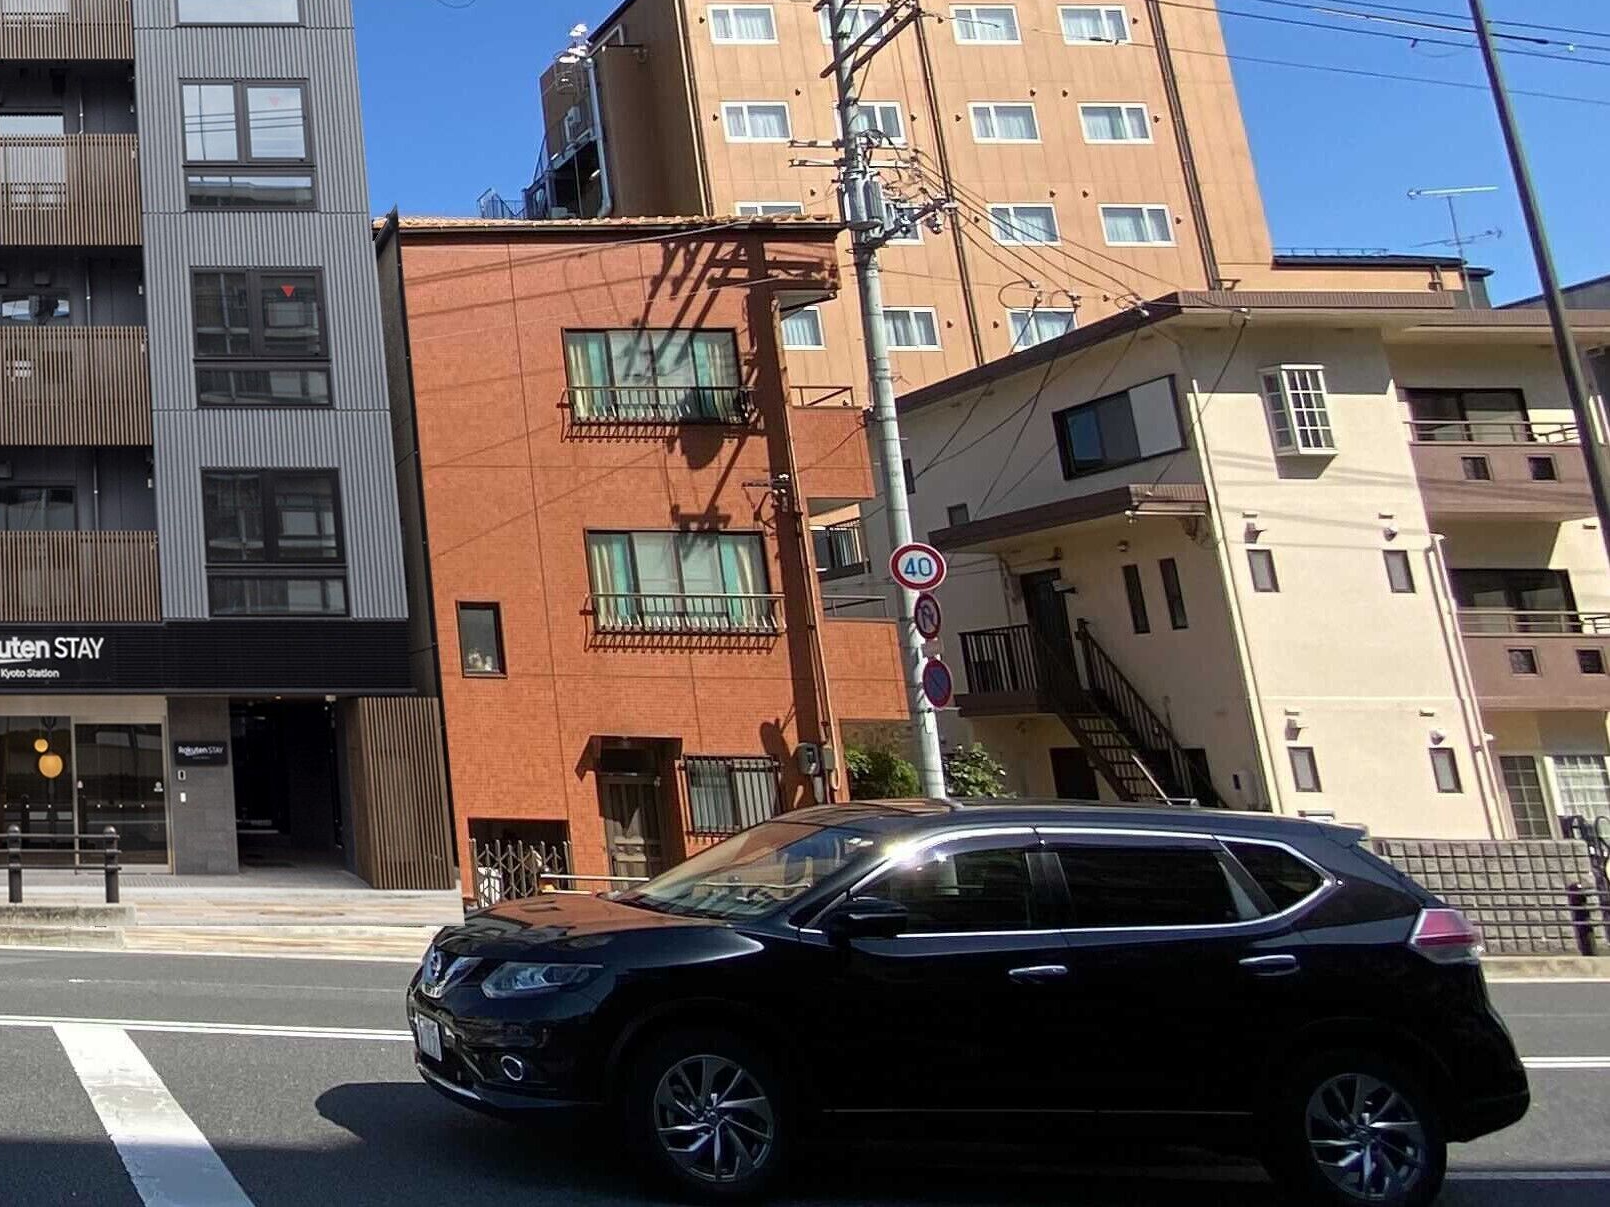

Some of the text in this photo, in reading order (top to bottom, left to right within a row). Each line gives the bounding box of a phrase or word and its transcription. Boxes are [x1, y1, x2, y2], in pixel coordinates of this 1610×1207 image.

[904, 557, 933, 578] 40
[54, 636, 104, 659] STAY
[0, 668, 60, 679] Kyoto Station
